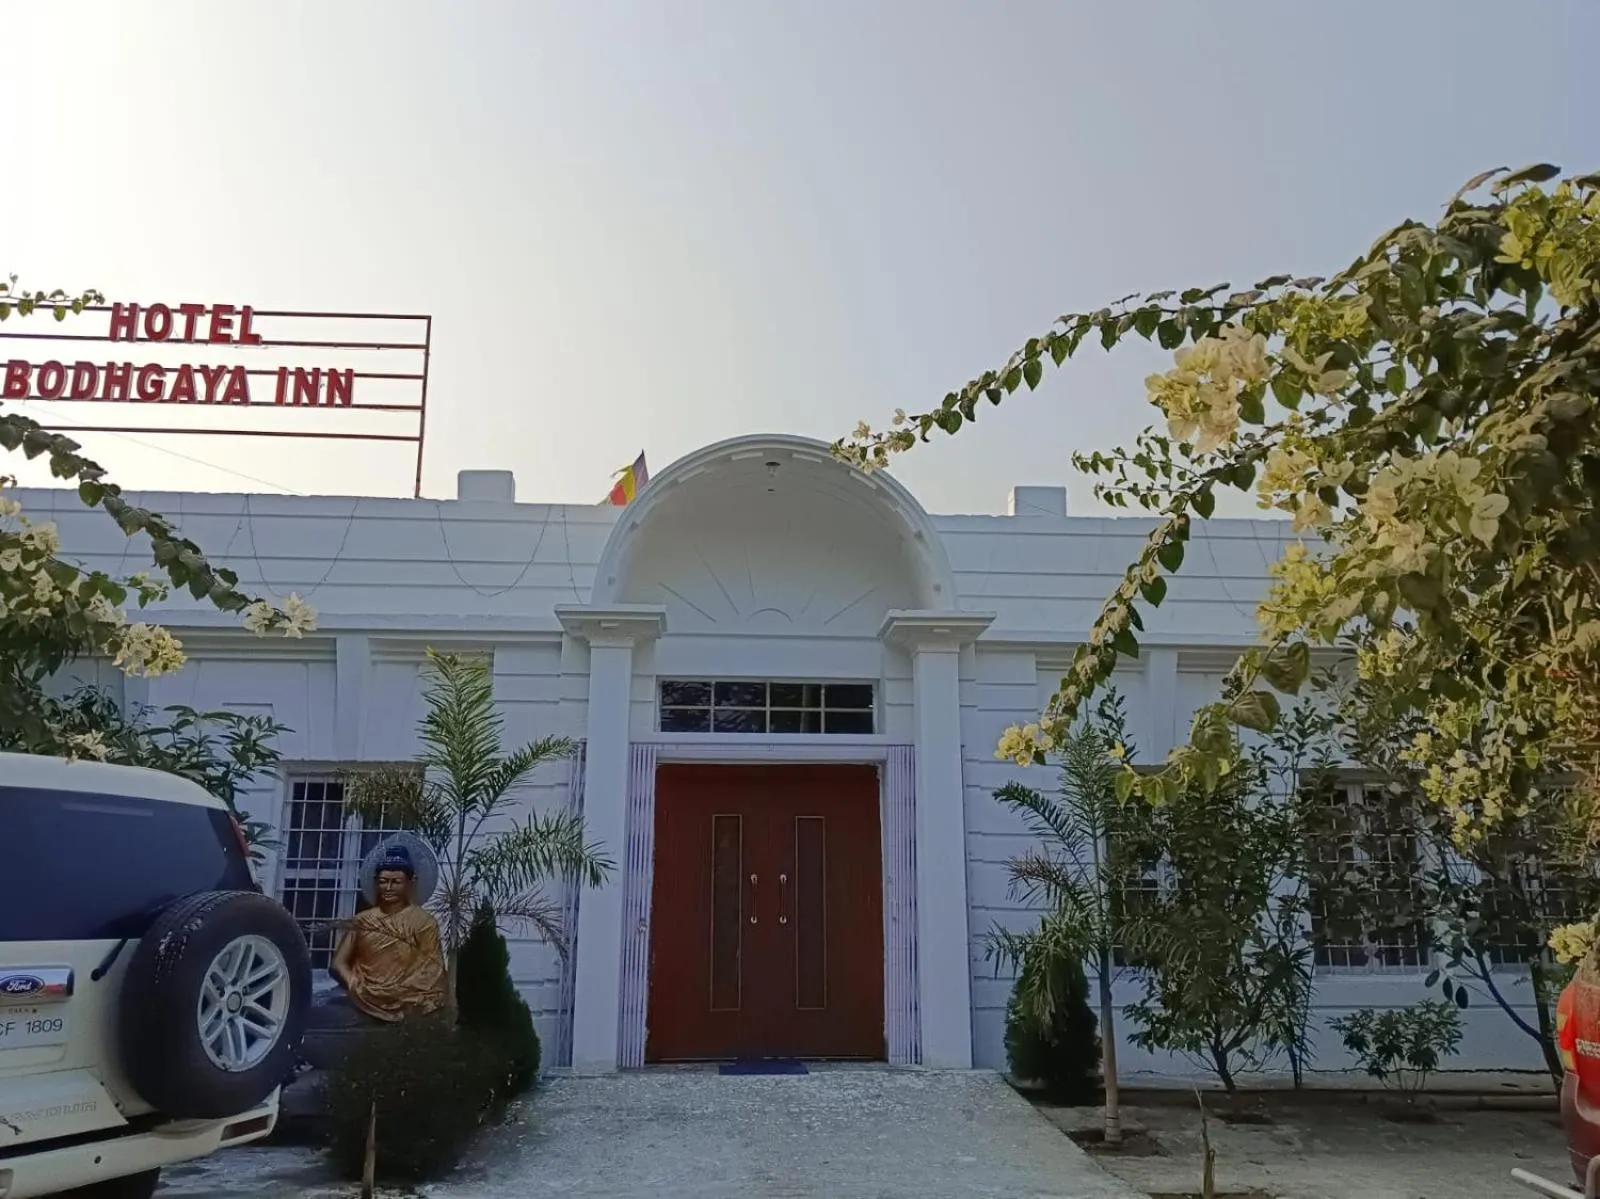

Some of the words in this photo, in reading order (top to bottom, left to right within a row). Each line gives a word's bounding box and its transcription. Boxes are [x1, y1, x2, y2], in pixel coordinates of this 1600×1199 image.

[109, 302, 262, 345] HOTEL
[3, 360, 250, 404] BODHGAYA
[275, 366, 354, 407] INN
[6, 980, 32, 991] Ford
[25, 1018, 63, 1034] 1809
